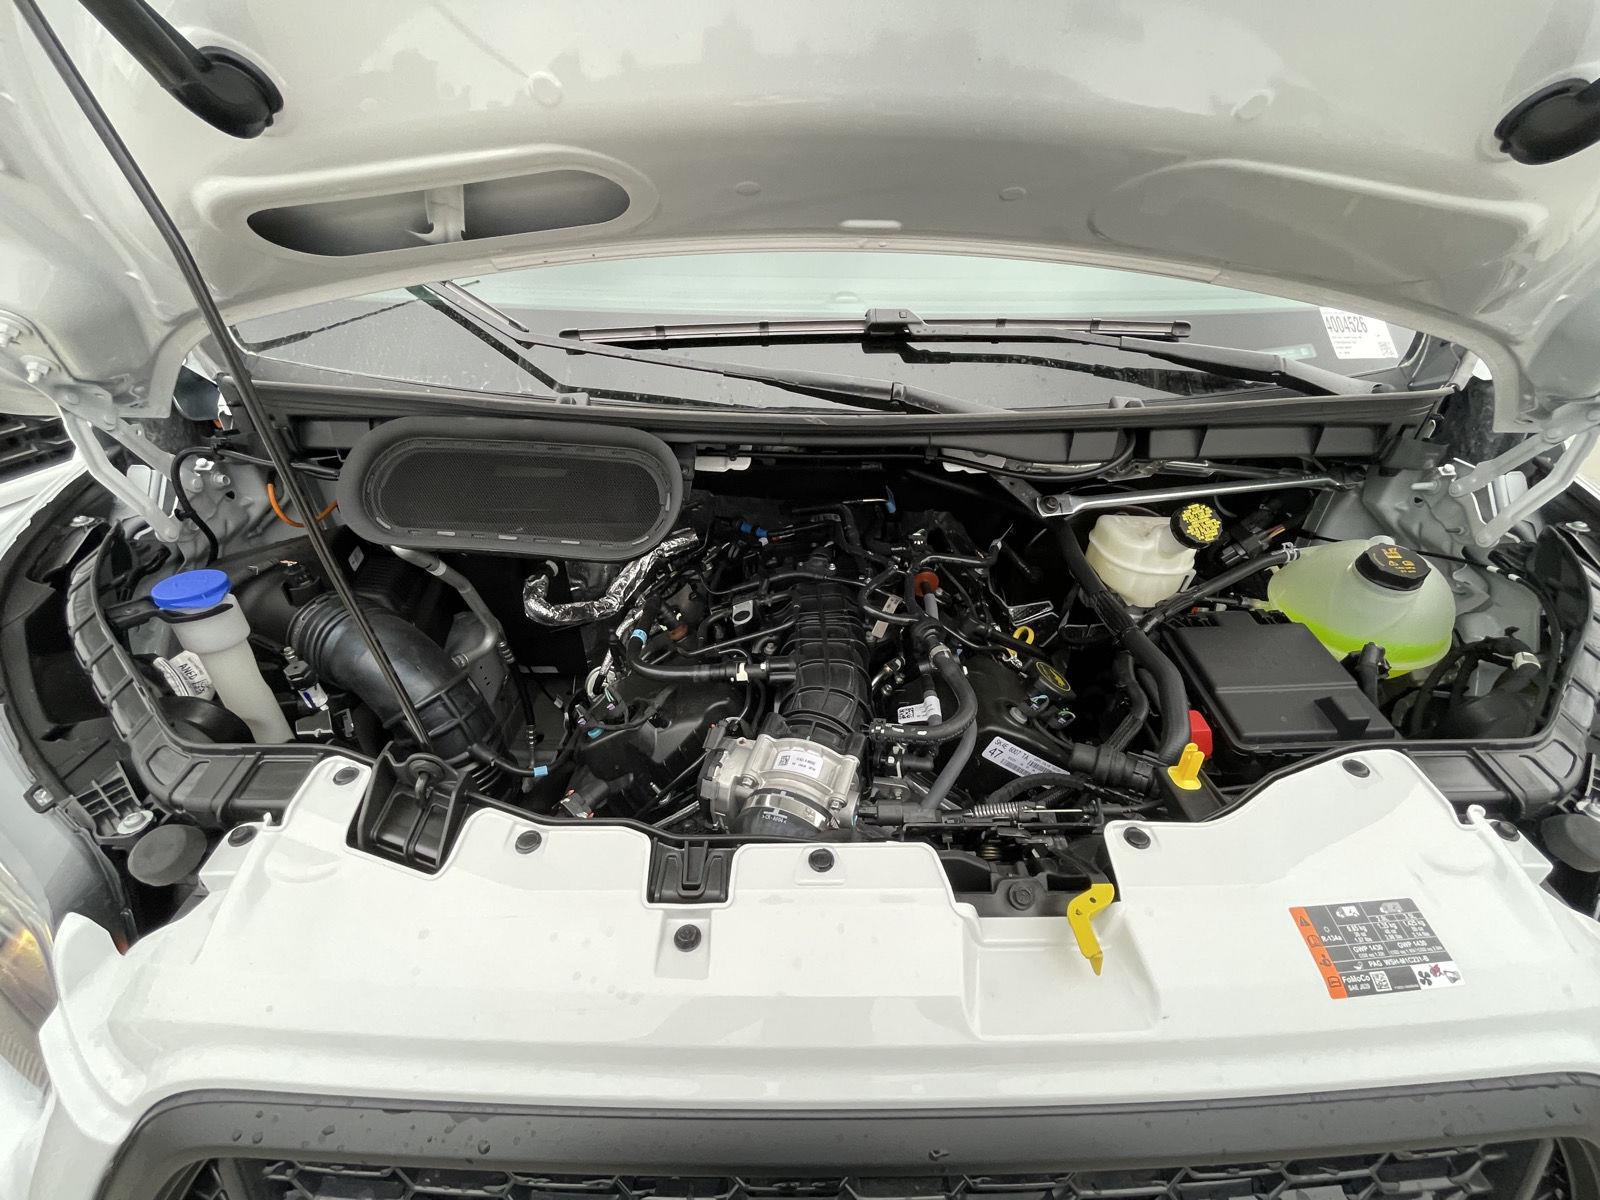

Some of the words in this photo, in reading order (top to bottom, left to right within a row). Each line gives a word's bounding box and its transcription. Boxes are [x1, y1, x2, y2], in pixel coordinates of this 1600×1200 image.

[988, 747, 1004, 758] 47
[1352, 945, 1368, 953] GWP
[1396, 941, 1412, 949] GWP
[1367, 960, 1382, 968] PAG
[1342, 974, 1371, 984] FoMoCo
